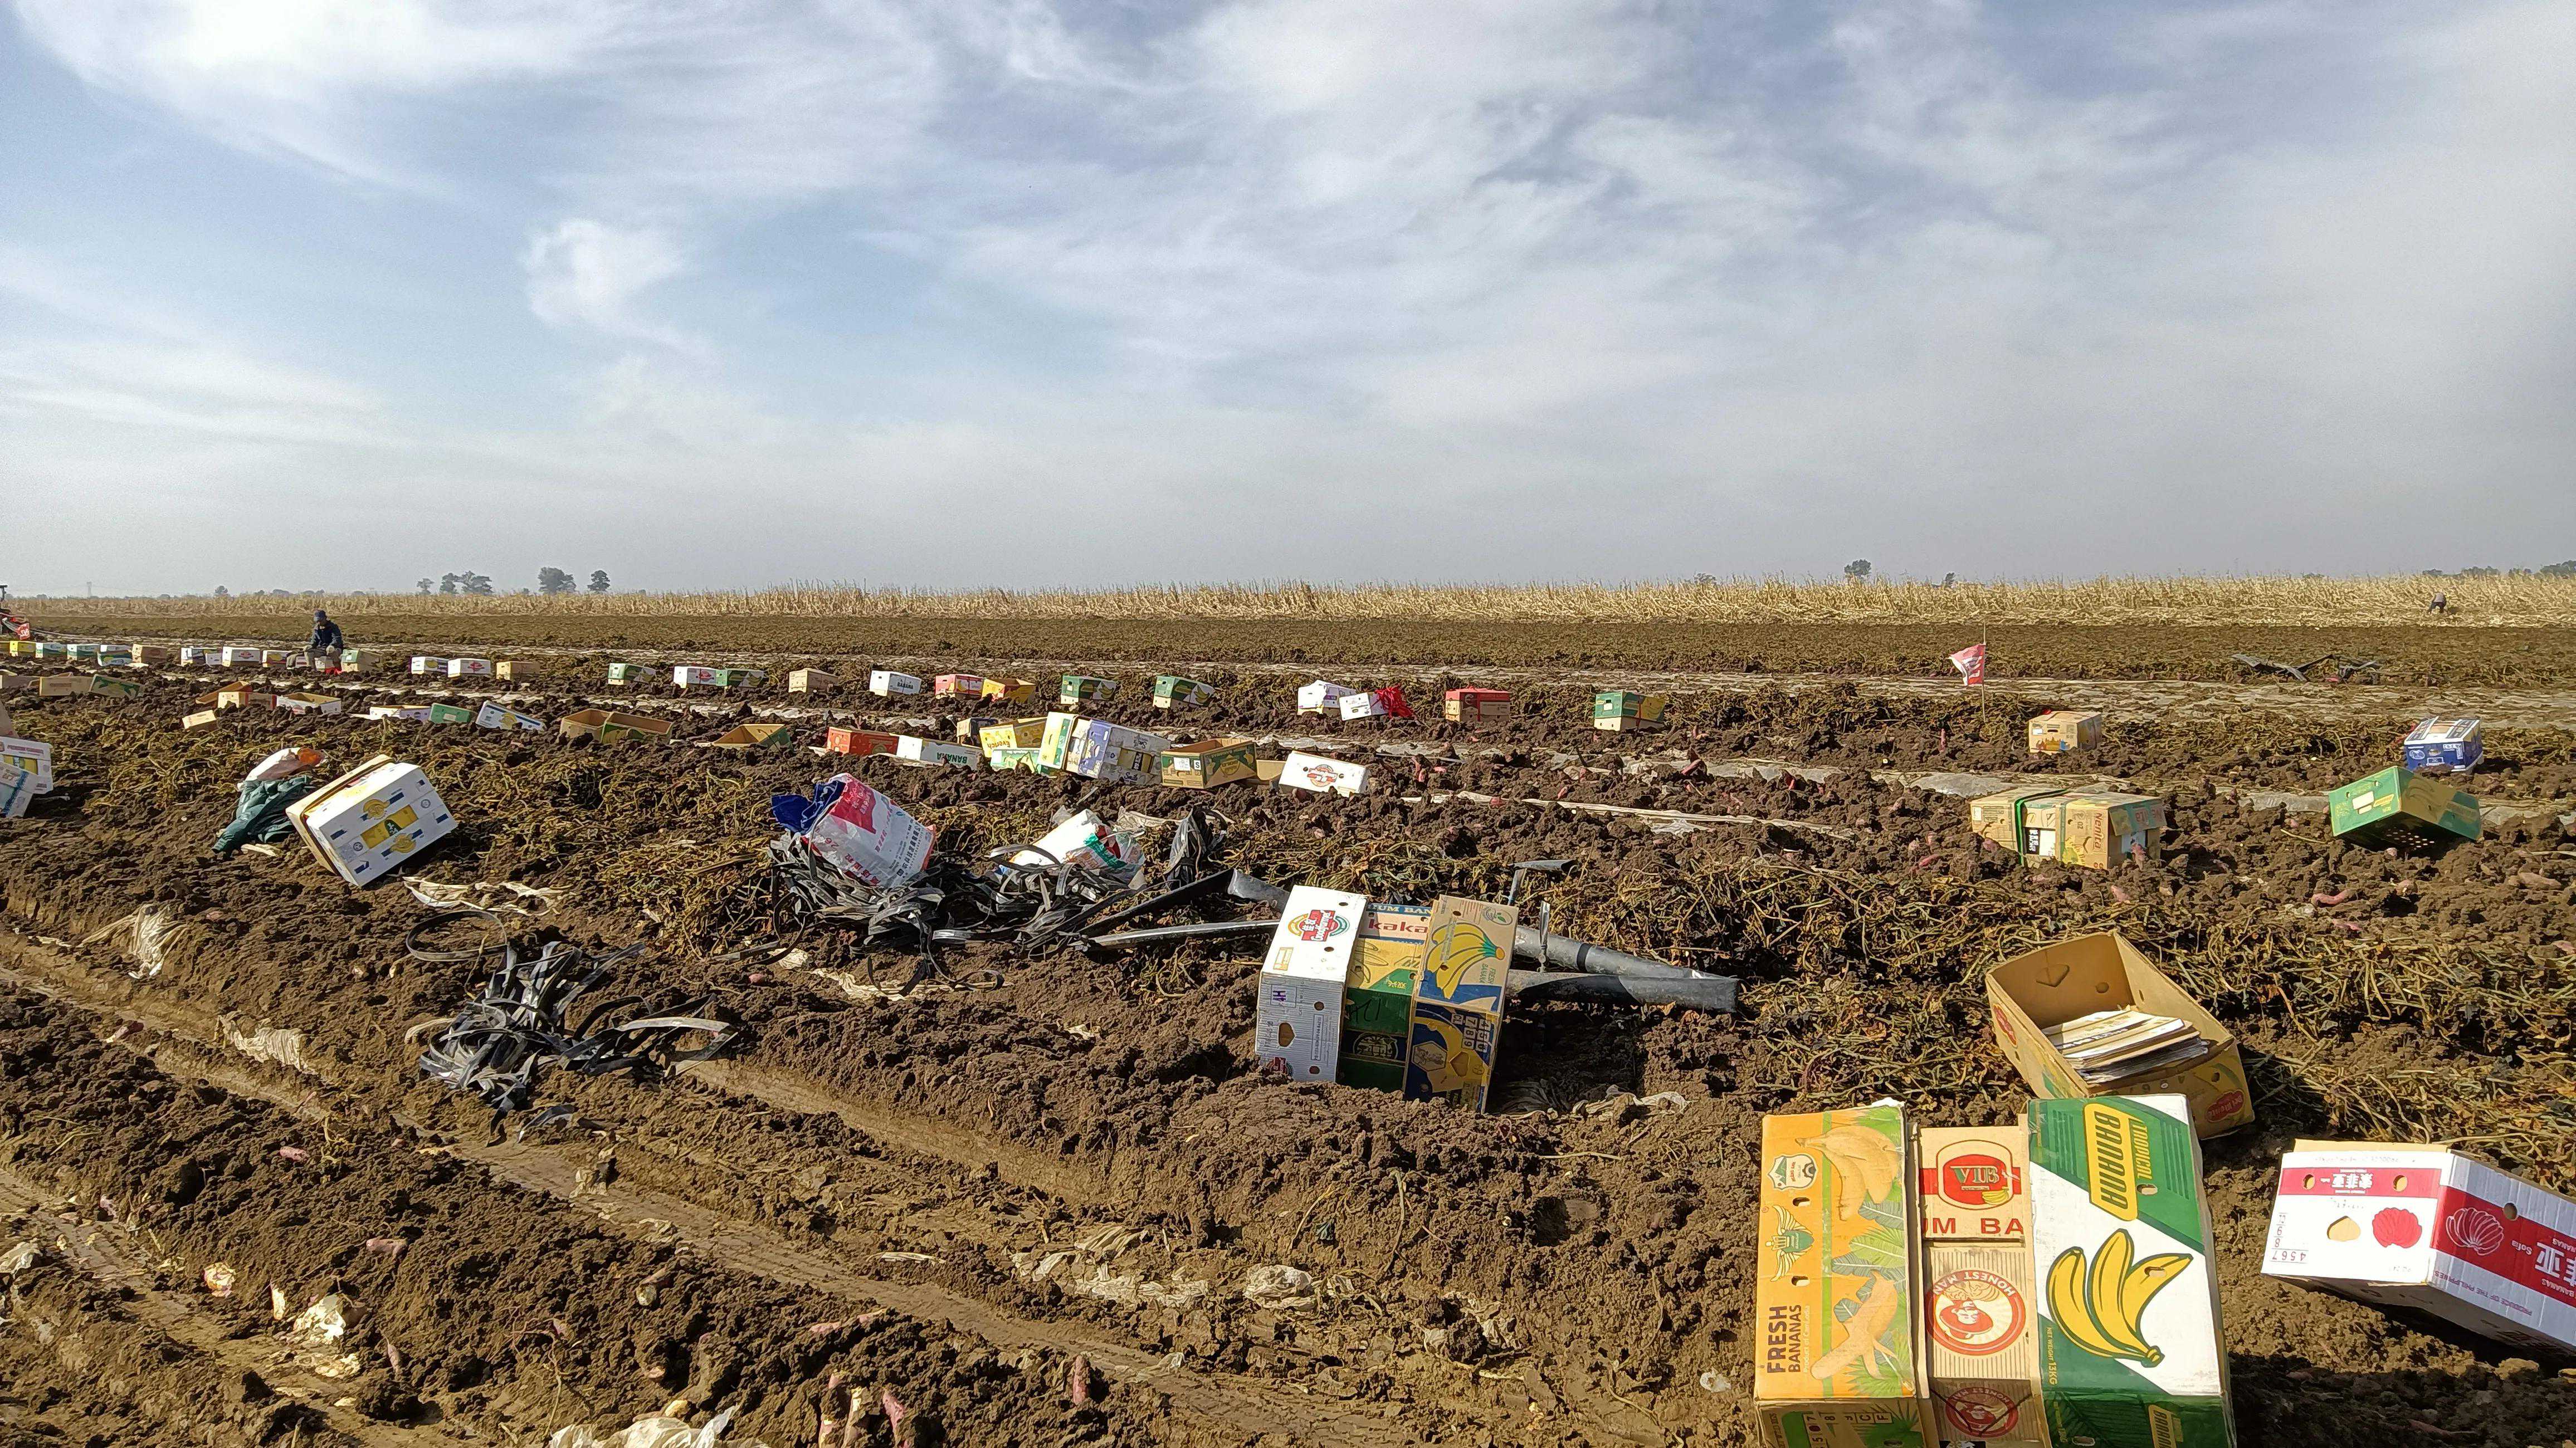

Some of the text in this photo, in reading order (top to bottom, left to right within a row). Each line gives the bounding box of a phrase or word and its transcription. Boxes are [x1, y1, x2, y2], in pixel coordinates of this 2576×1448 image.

[1368, 919, 1428, 933] kaka
[2094, 1111, 2129, 1210] BANANA
[1980, 1217, 2024, 1235] BA
[1933, 1270, 2016, 1297] HONEST MAN
[1767, 1305, 1787, 1373] FRESH
[1788, 1304, 1802, 1373] BANANAS
[2048, 1362, 2058, 1385] 13KG
